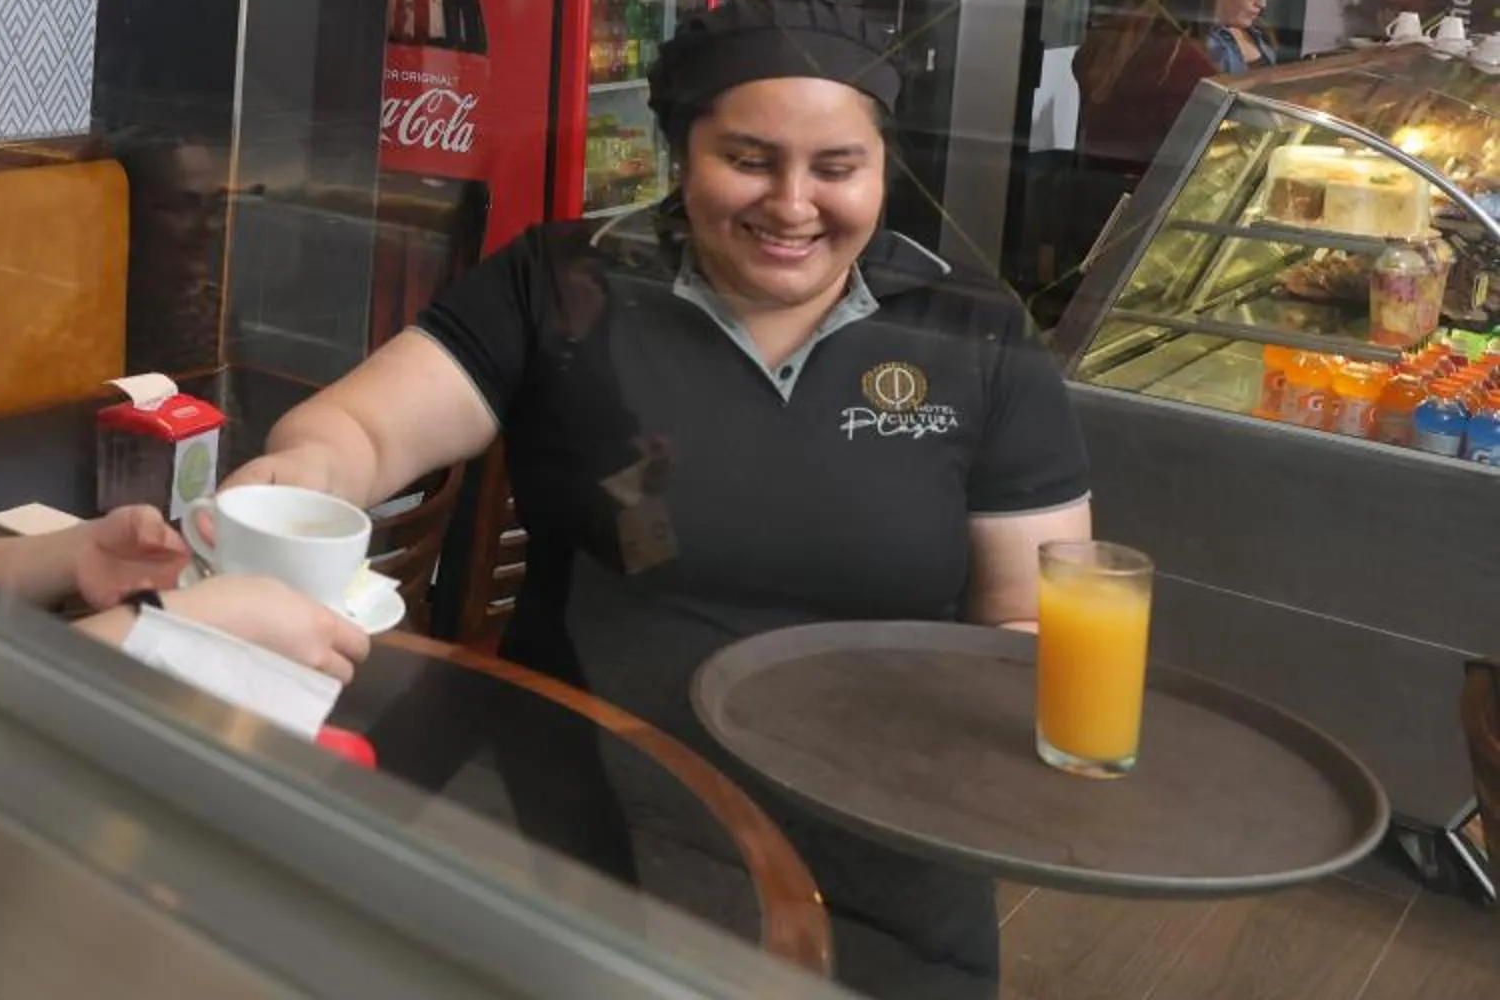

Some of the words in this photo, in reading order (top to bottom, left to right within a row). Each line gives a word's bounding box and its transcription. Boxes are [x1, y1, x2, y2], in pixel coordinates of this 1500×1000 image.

[401, 70, 454, 87] ORIGINAL
[914, 404, 957, 415] HOTEL
[888, 412, 960, 429] CULTURA
